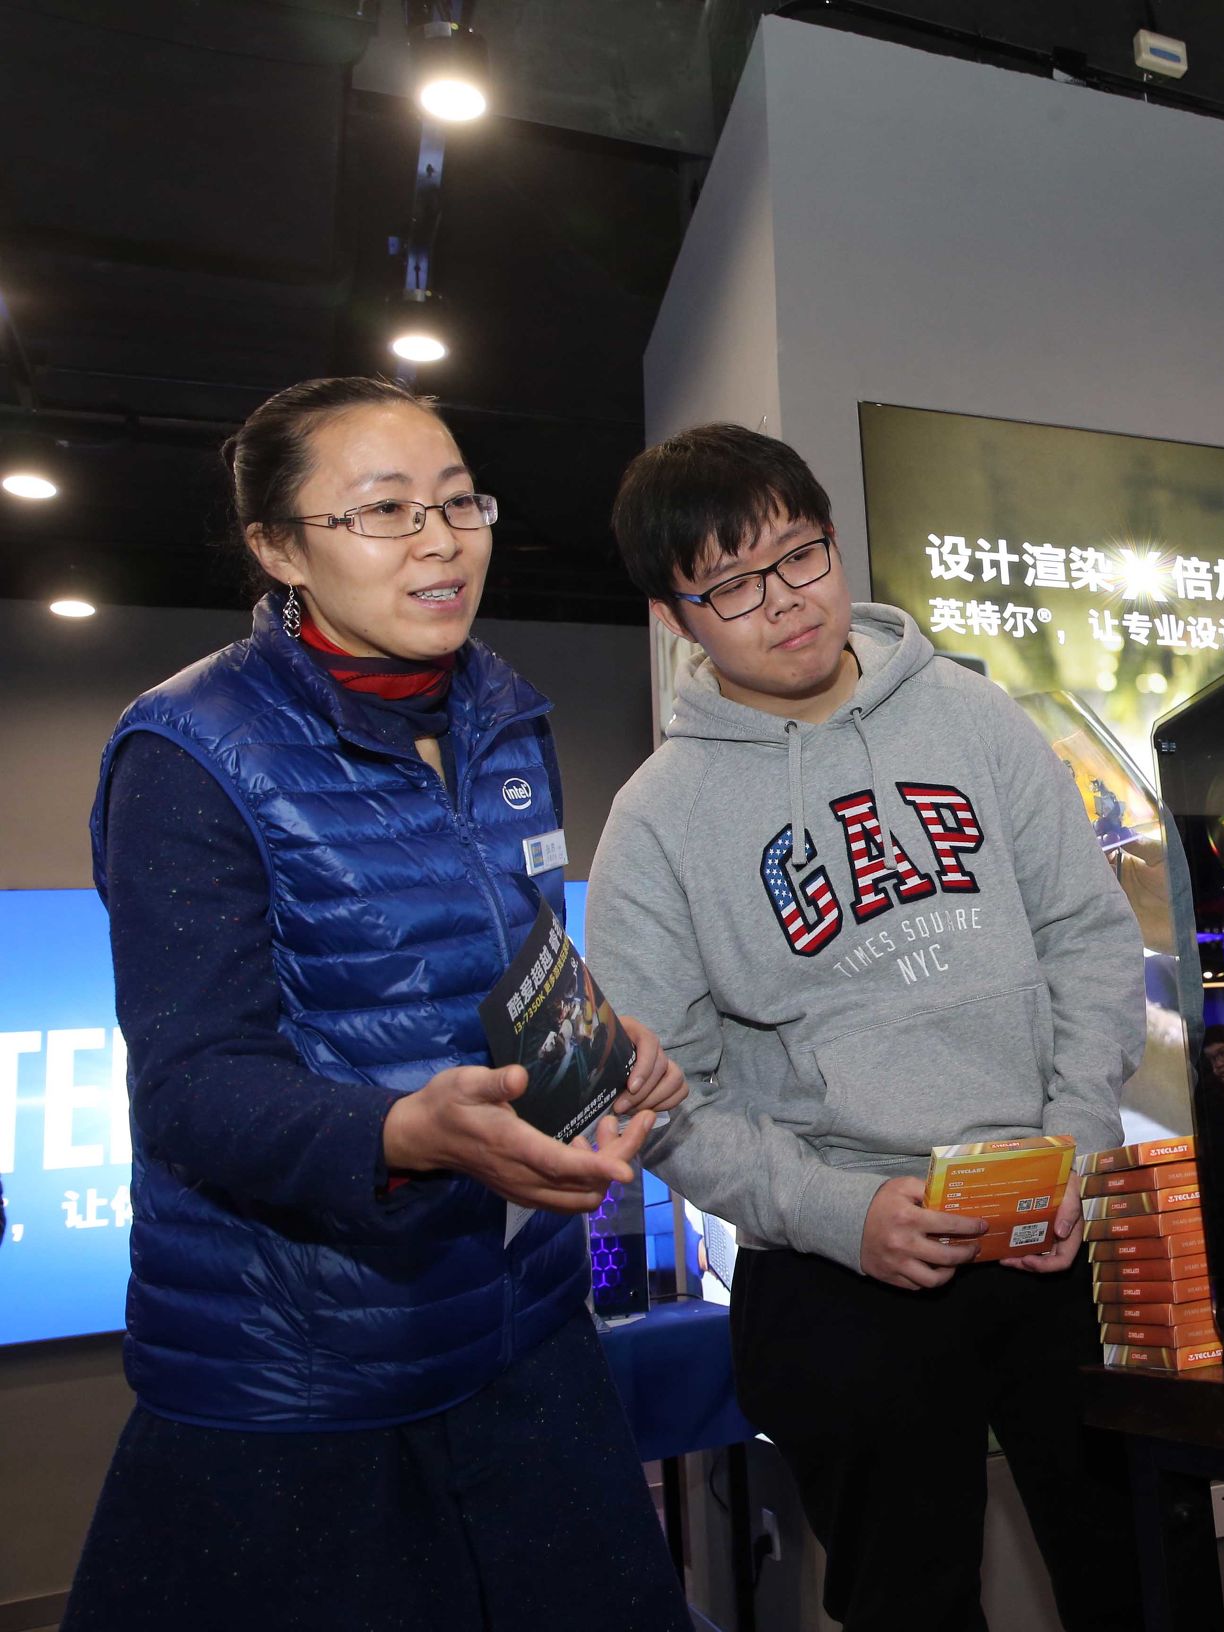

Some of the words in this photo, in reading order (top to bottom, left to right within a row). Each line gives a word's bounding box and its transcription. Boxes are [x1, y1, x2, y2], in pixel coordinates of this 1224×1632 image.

[760, 781, 985, 957] GAP
[833, 931, 896, 978] TIMES
[901, 908, 982, 941] SQUARE
[897, 944, 949, 985] NYC
[506, 946, 554, 1022] 酷爱超越
[1156, 1145, 1188, 1155] TECLAST
[1173, 1191, 1201, 1202] TECLAS
